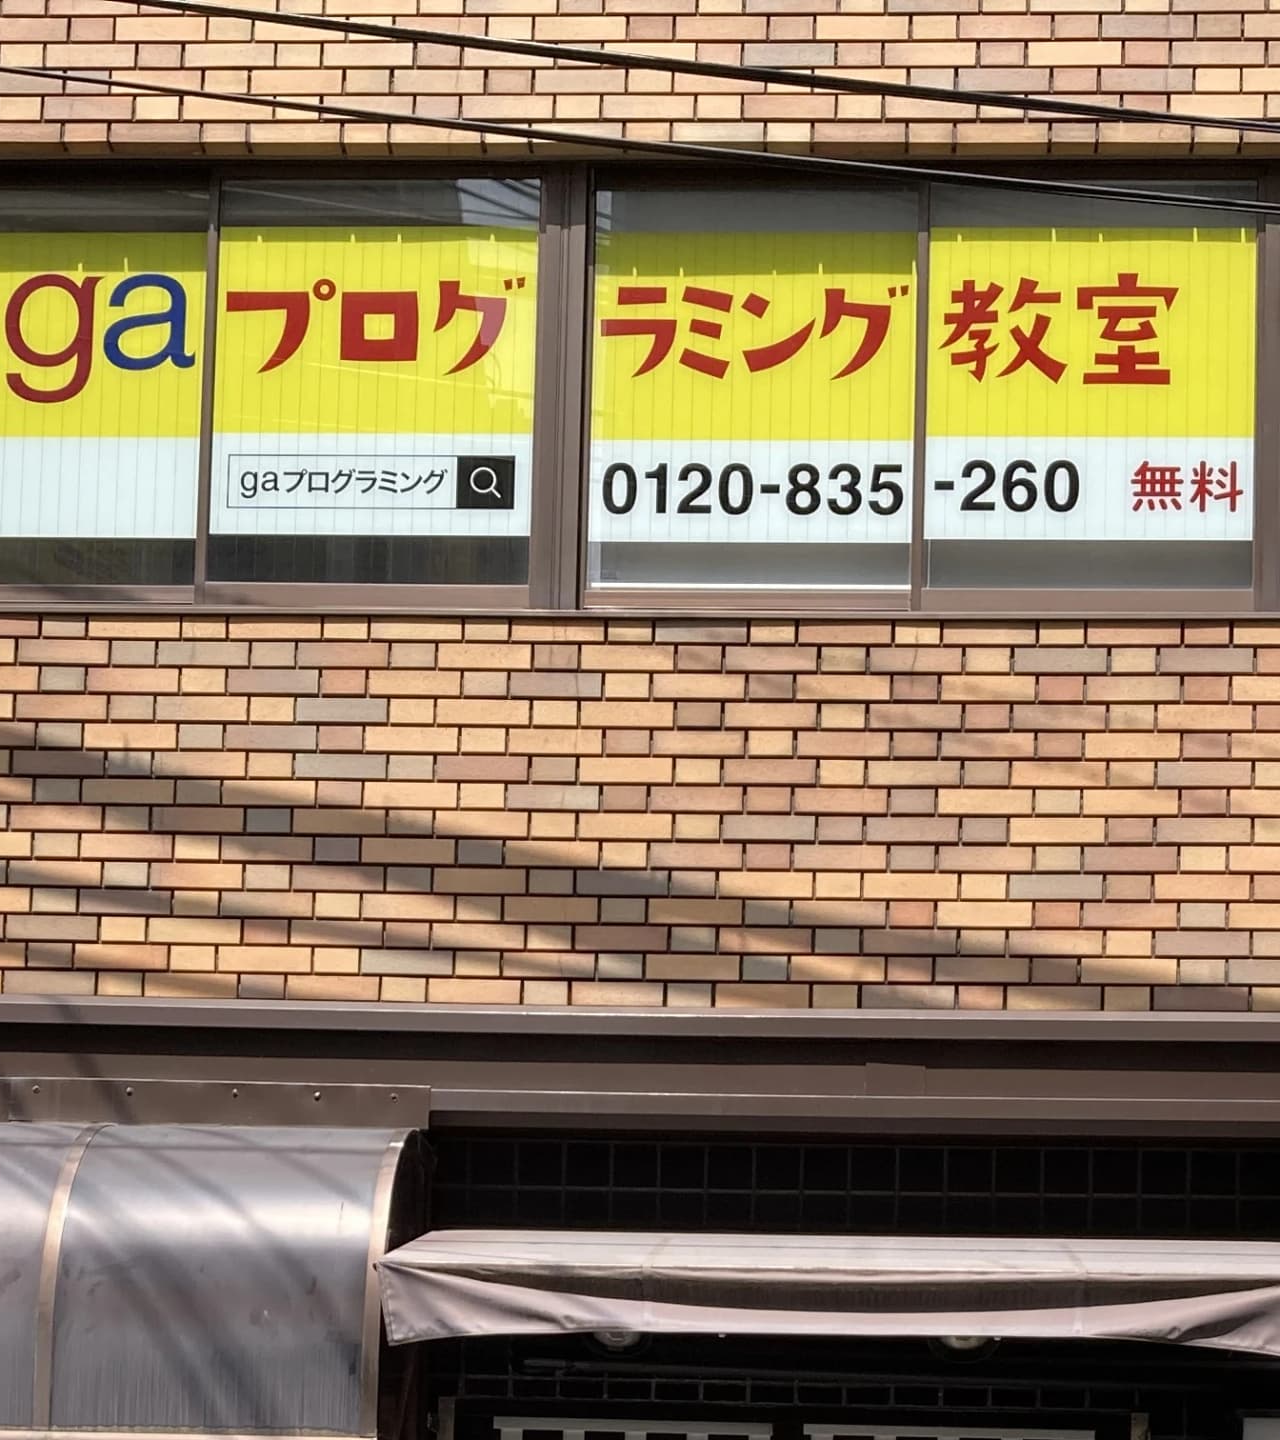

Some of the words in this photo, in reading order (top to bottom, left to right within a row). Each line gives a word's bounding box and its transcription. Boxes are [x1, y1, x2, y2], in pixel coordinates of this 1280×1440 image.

[239, 466, 449, 499] gaプログラミング
